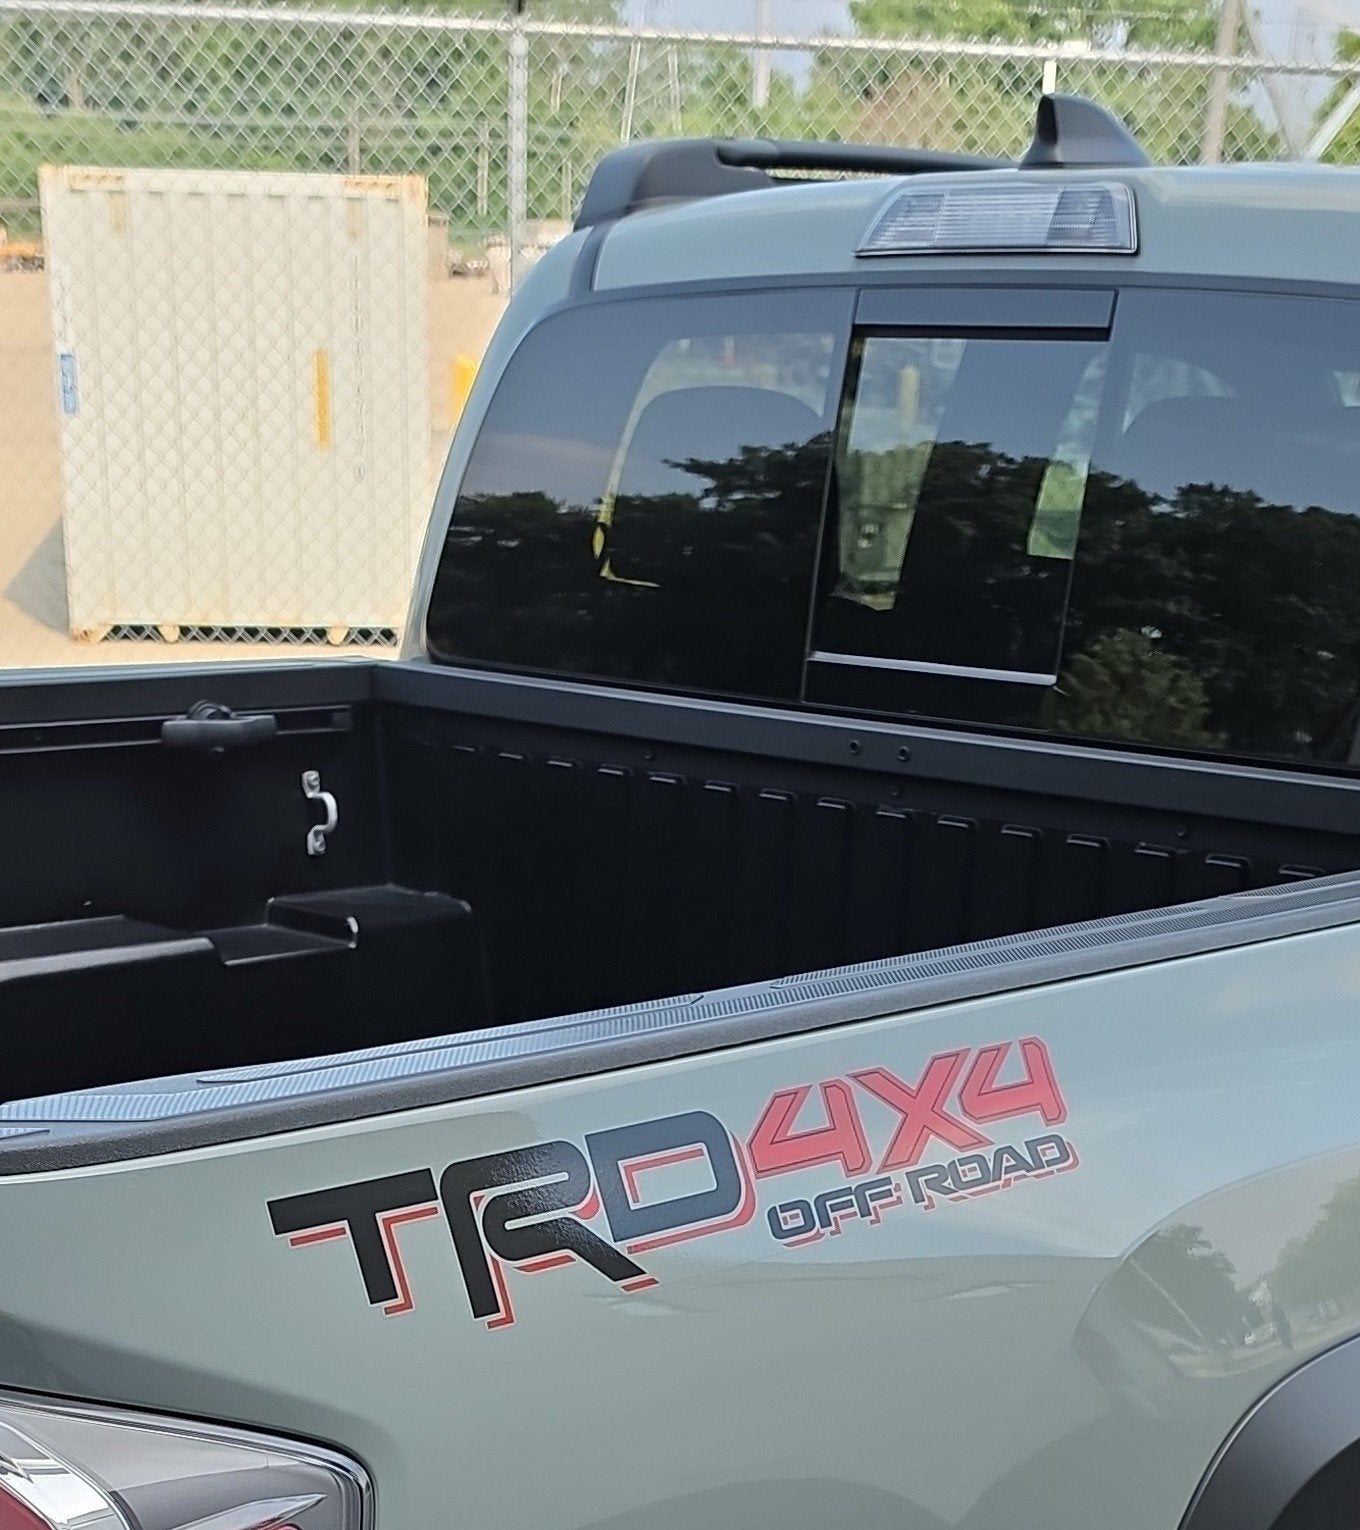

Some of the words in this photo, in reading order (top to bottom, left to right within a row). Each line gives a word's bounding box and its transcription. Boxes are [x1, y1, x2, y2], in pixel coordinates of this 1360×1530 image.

[266, 1109, 758, 1329] TRD
[766, 1174, 904, 1247] OFF
[904, 1132, 1080, 1213] ROAD
